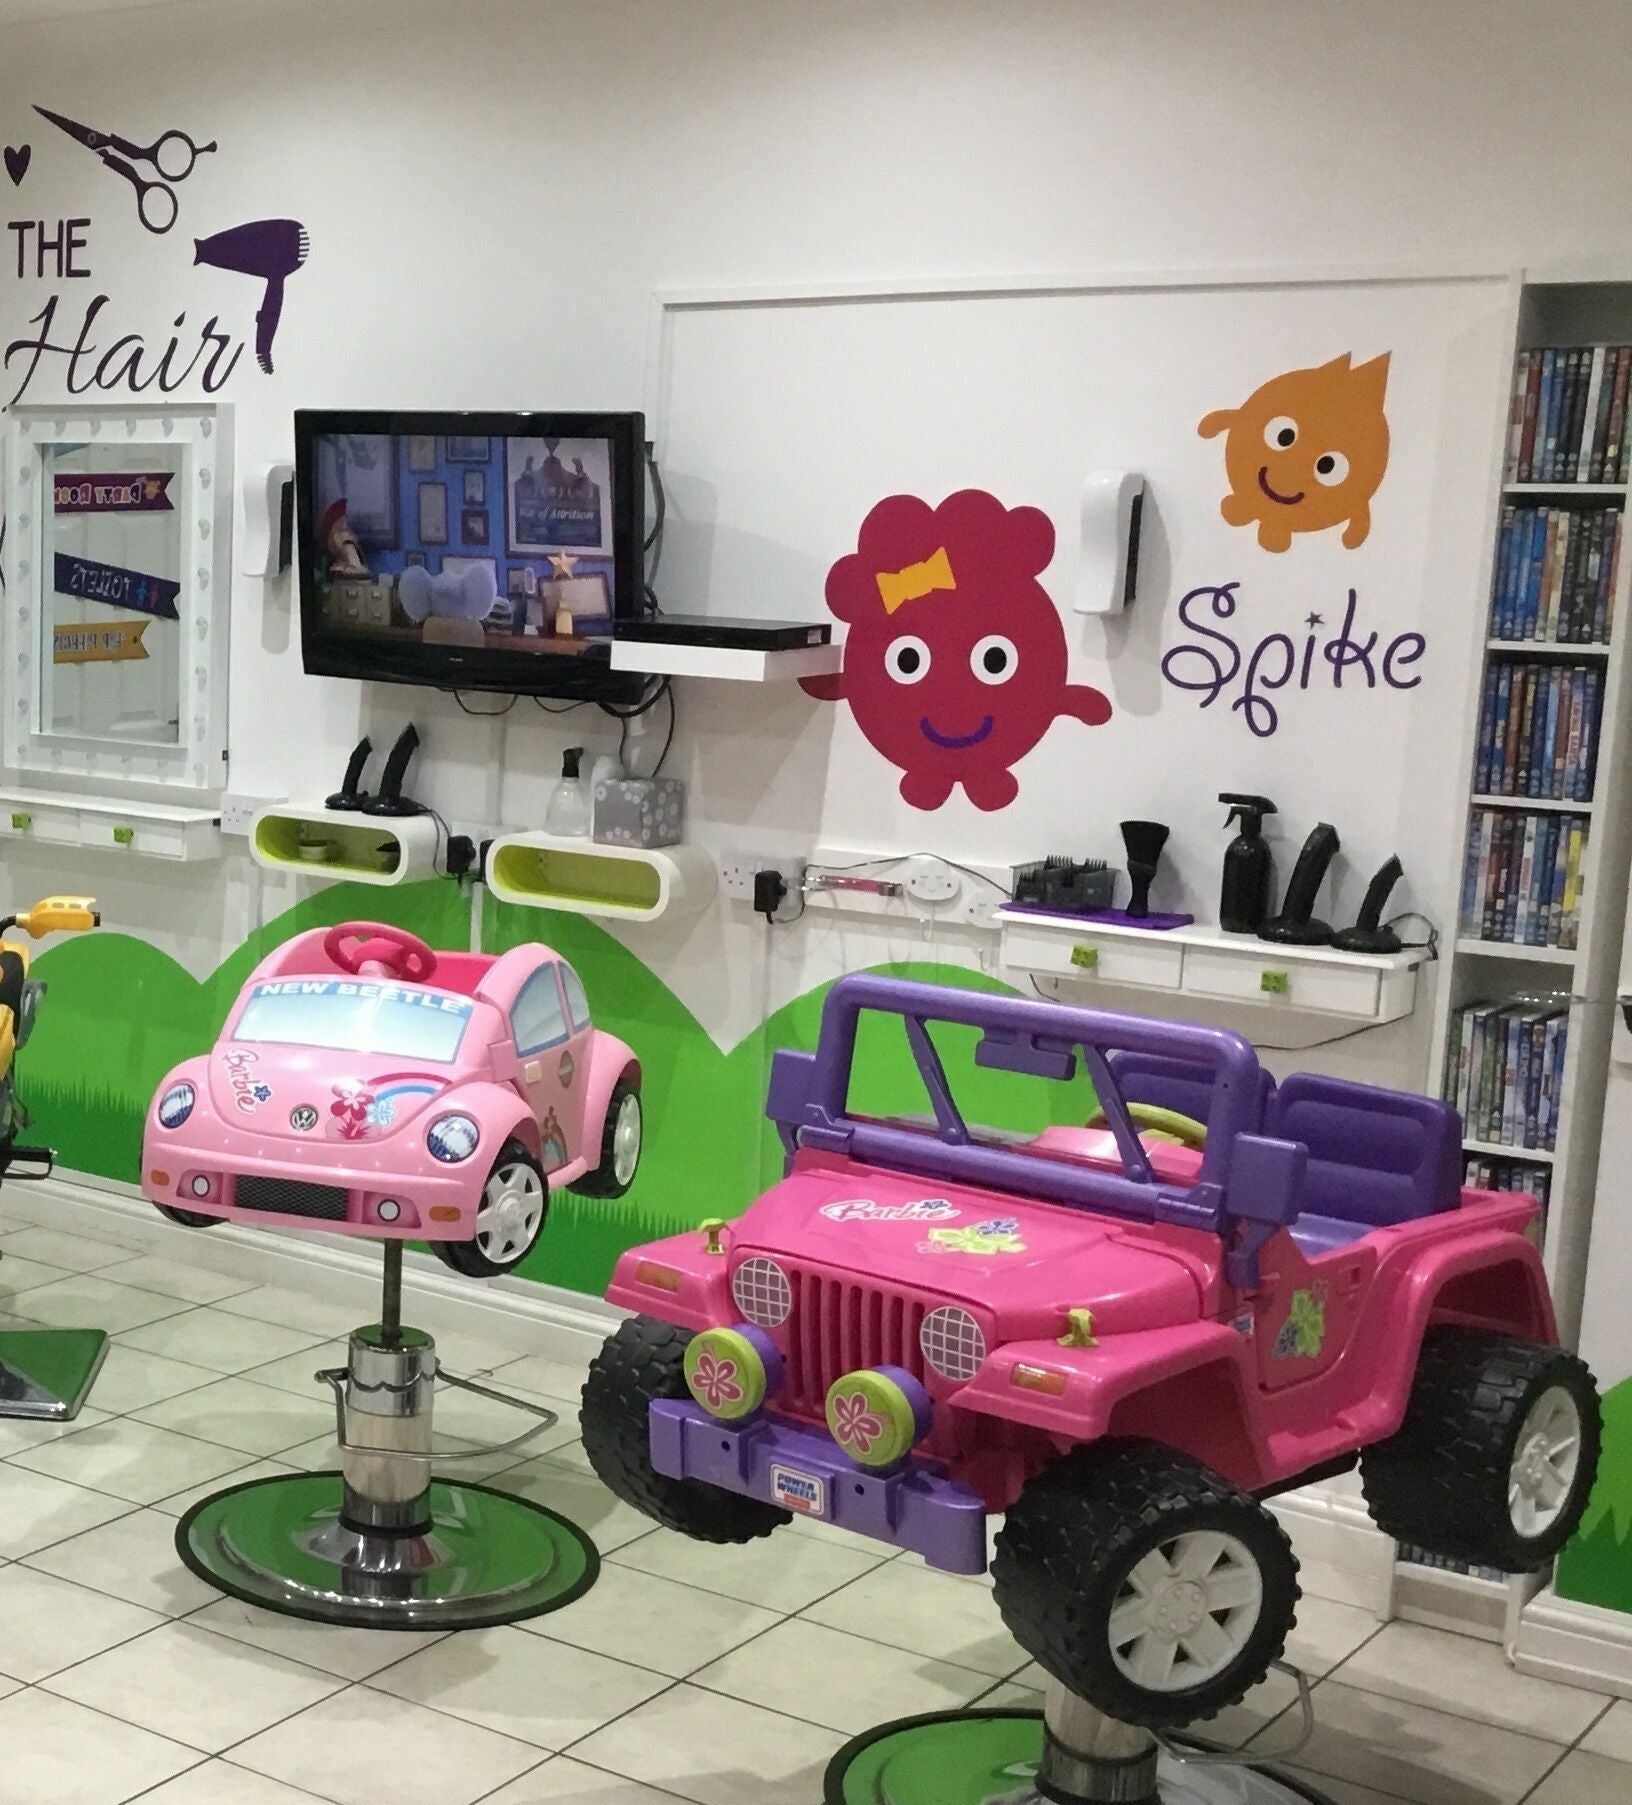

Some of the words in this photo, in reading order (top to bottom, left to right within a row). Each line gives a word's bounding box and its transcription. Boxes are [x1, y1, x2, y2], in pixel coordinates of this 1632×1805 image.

[7, 218, 92, 279] THE
[1, 294, 245, 413] Hair
[1161, 581, 1426, 737] Spike
[260, 983, 329, 996] NEW
[337, 984, 465, 1014] BEETLE
[221, 1048, 262, 1113] Barbie
[823, 1200, 960, 1220] Barbie
